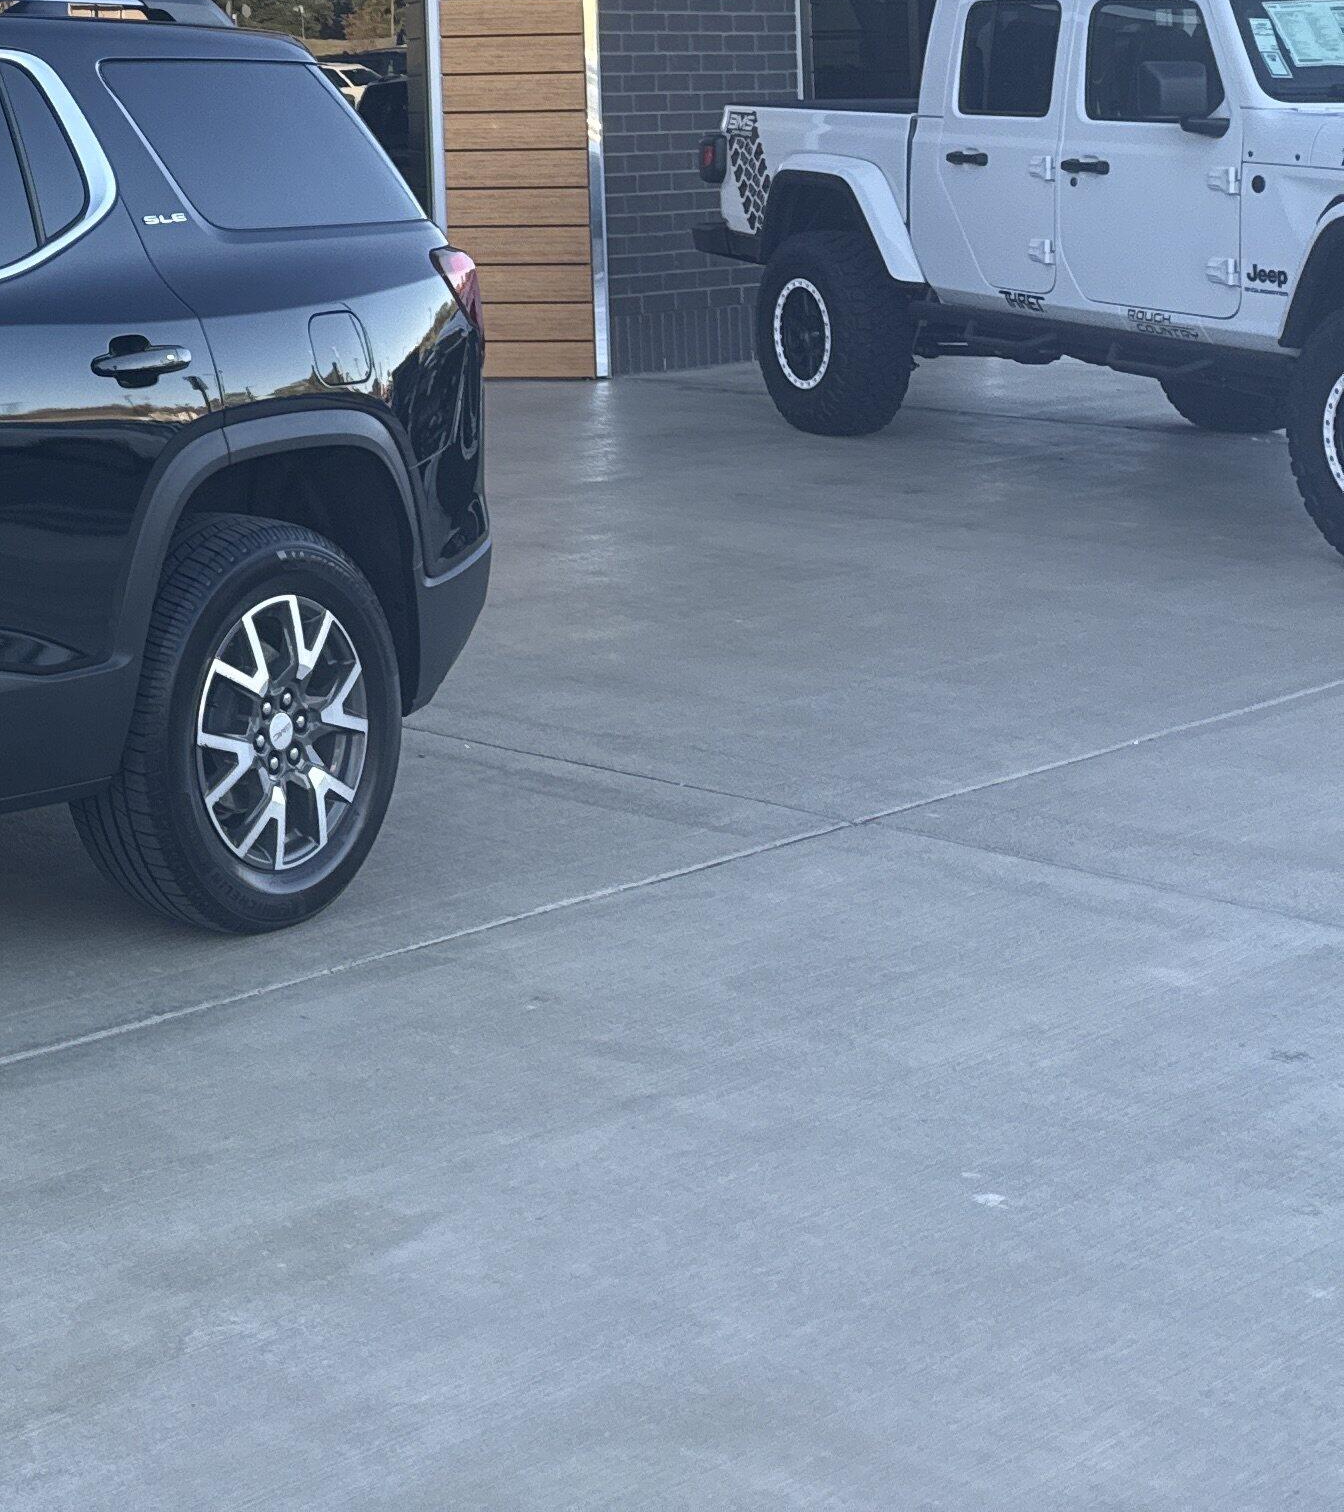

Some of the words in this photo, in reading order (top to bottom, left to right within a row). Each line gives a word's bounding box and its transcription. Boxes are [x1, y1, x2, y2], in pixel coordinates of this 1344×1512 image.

[143, 212, 188, 225] SLE
[1246, 263, 1289, 288] Jeep
[1127, 308, 1172, 325] ROUGH
[1137, 323, 1199, 342] COUNTRY
